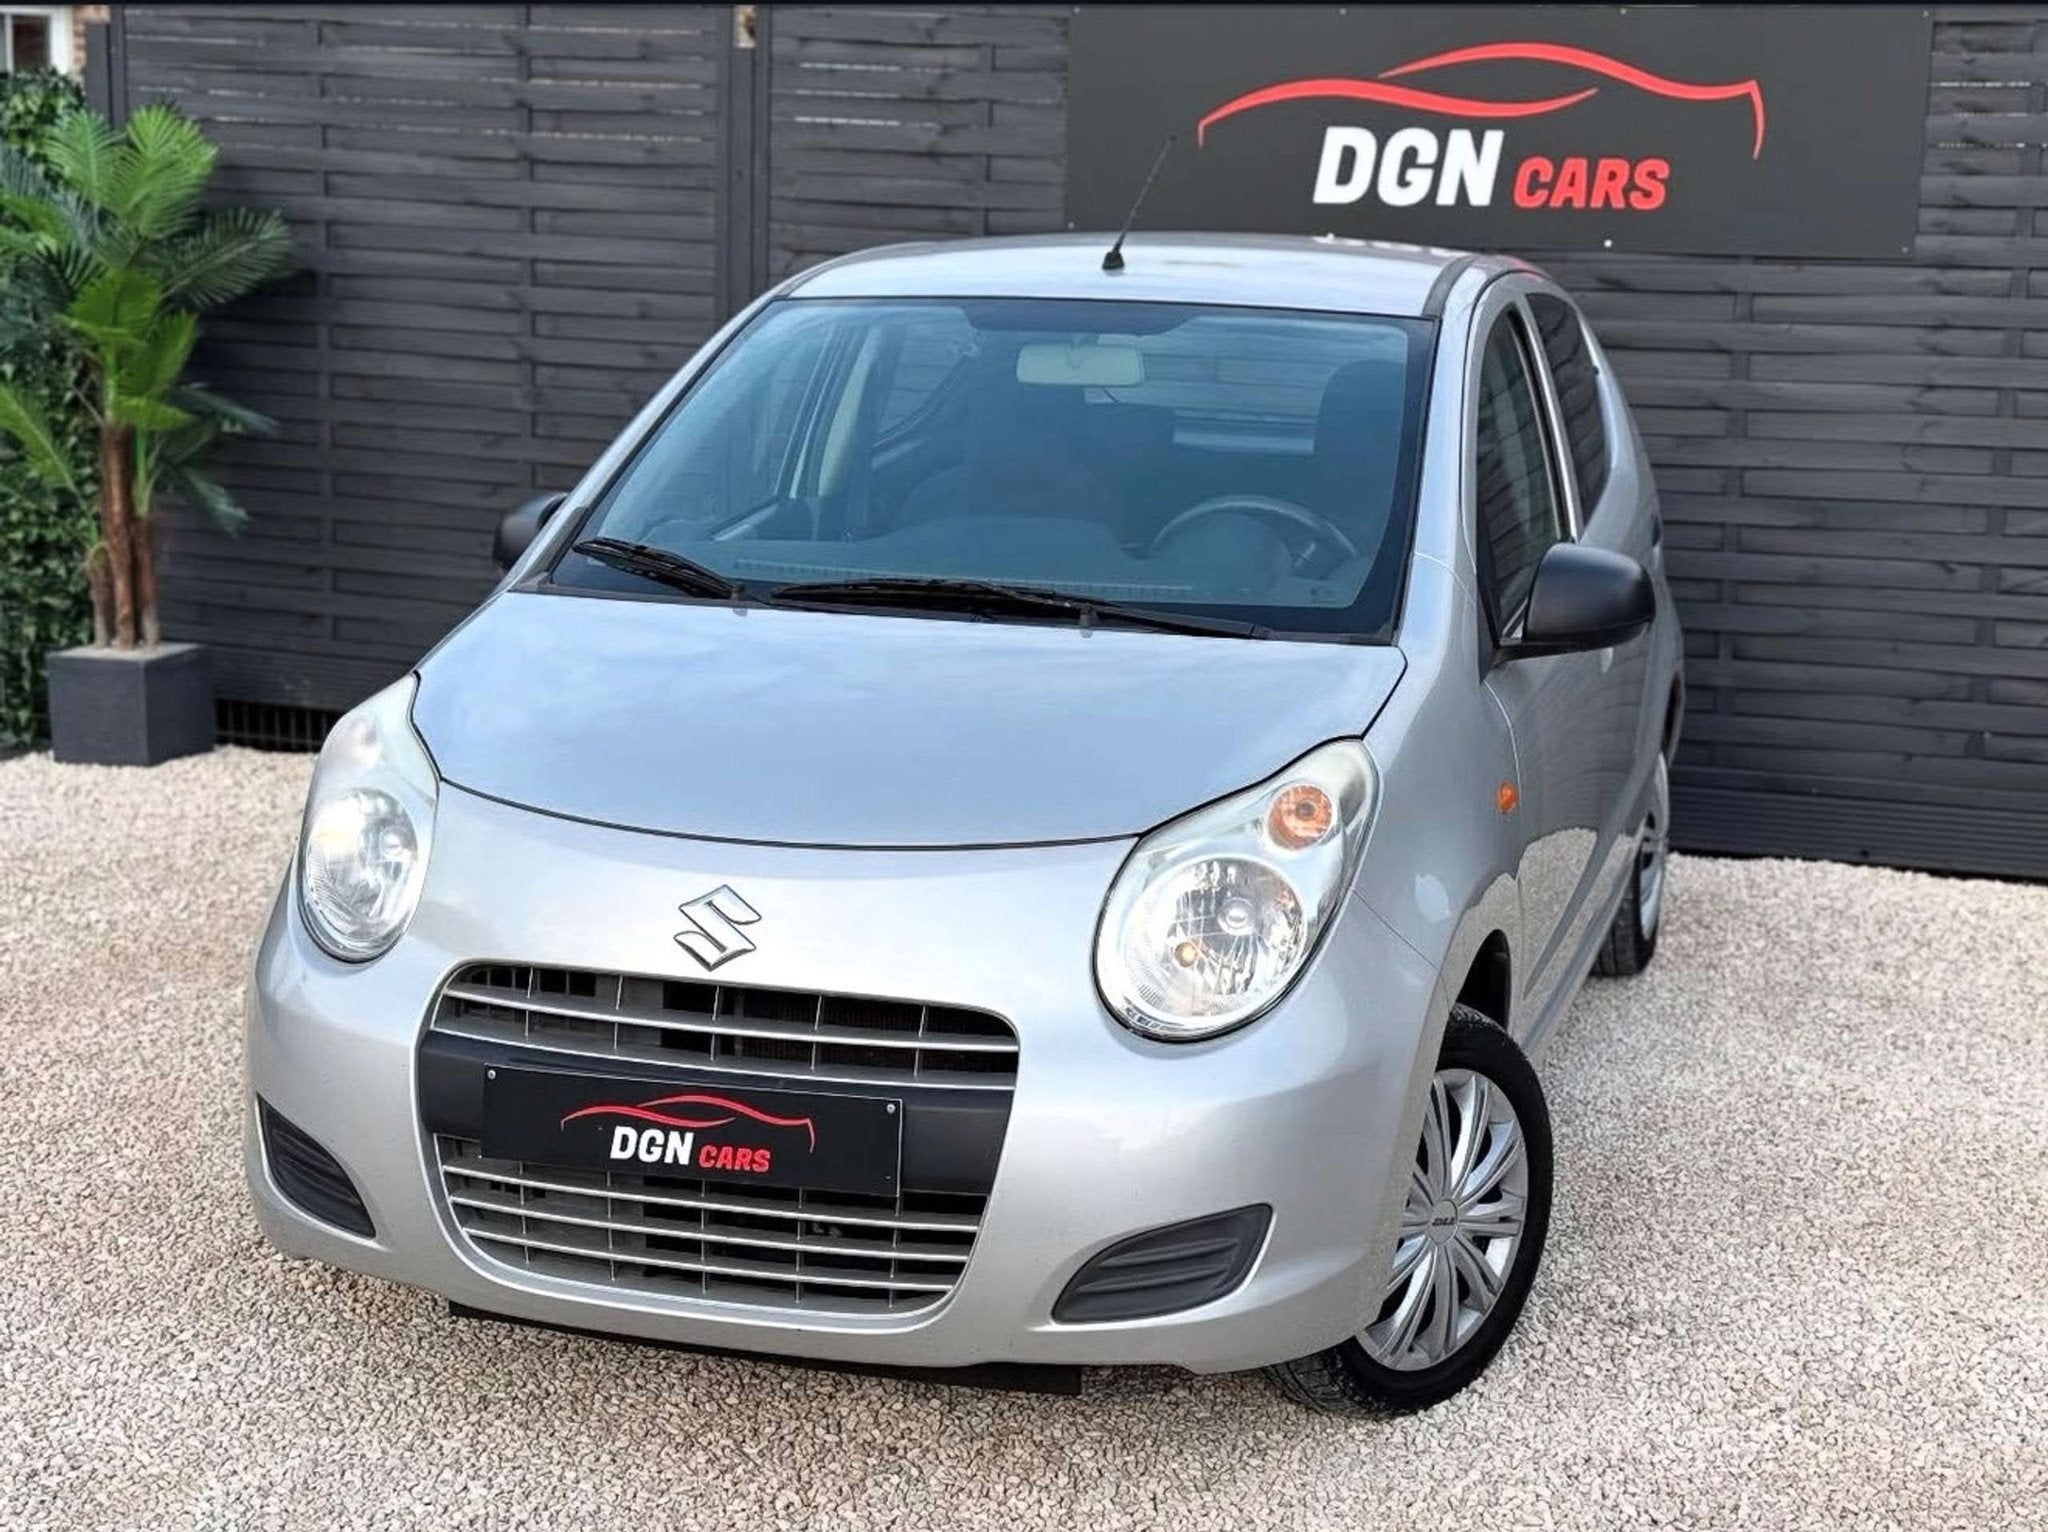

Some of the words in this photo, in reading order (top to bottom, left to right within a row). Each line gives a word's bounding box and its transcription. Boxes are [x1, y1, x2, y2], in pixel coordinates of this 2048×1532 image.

[1313, 126, 1505, 207] DGN
[1513, 156, 1671, 210] CARS
[609, 1125, 695, 1165] DGN
[698, 1145, 771, 1172] CARS
